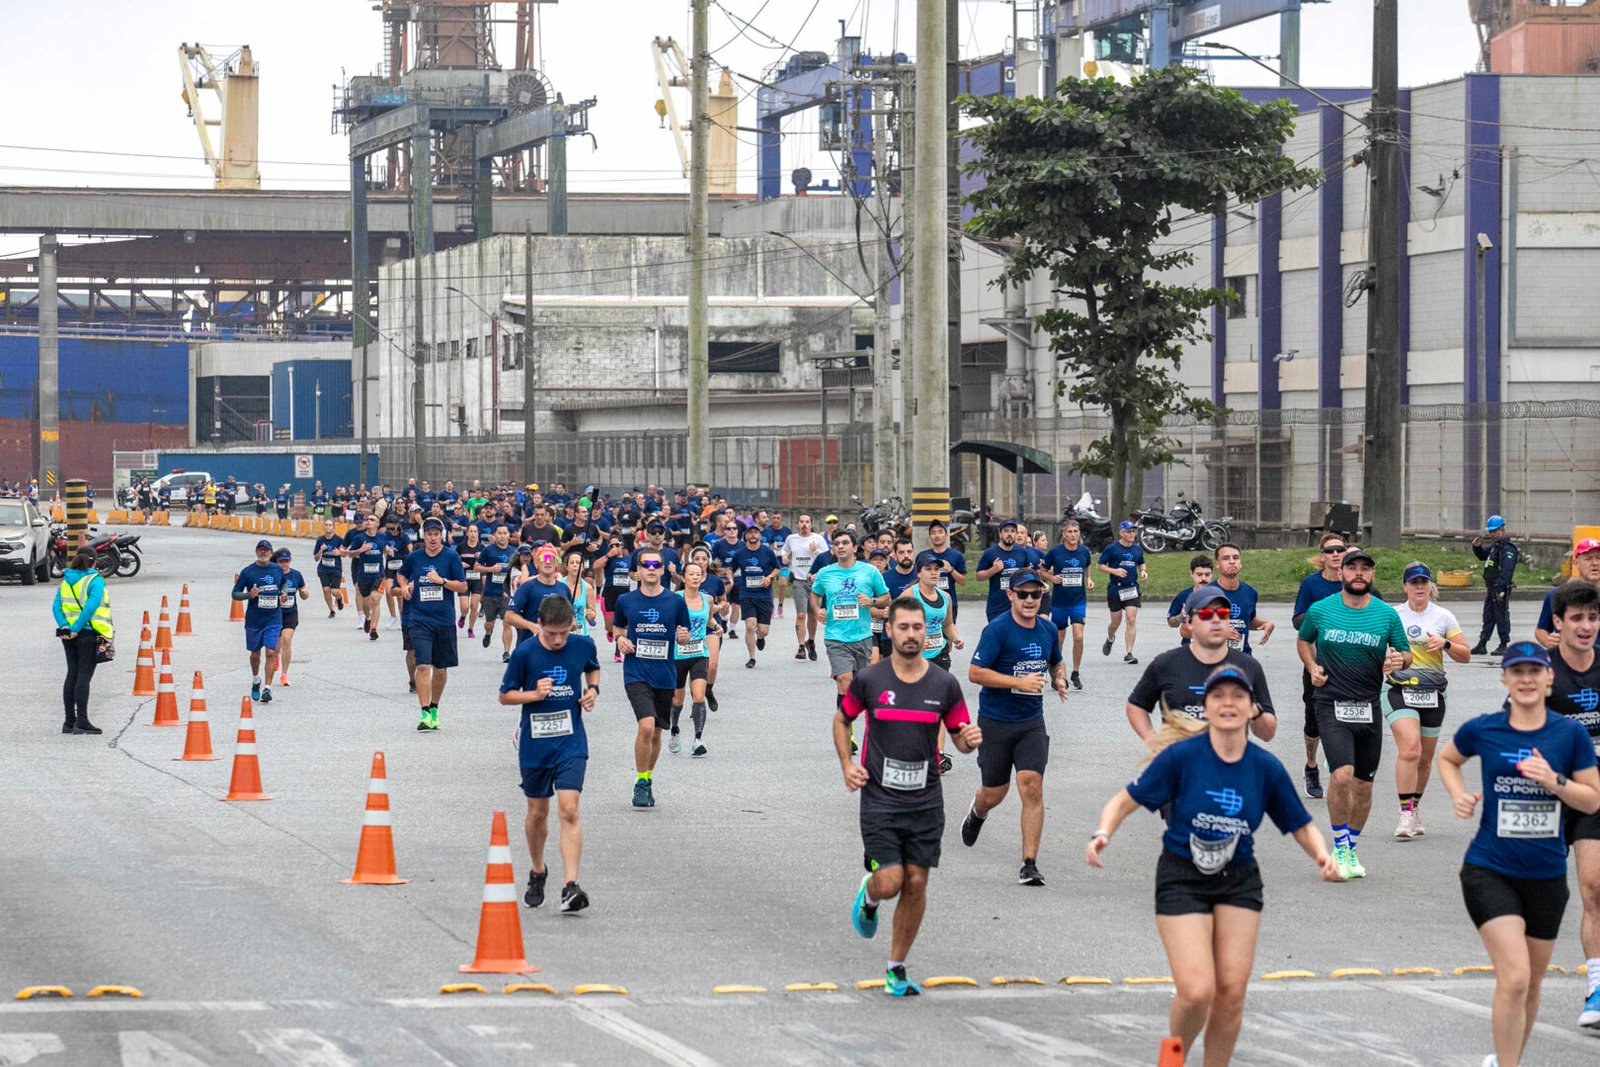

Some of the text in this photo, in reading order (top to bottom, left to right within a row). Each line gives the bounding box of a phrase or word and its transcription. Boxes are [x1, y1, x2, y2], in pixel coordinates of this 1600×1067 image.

[1343, 707, 1365, 716] 2536
[540, 719, 564, 731] 2257
[893, 771, 920, 781] 2117
[1493, 783, 1511, 793] DO
[1197, 812, 1249, 829] CORRIDA
[1512, 813, 1548, 827] 2362
[1191, 818, 1210, 830] DO
[1211, 823, 1251, 836] PORTO
